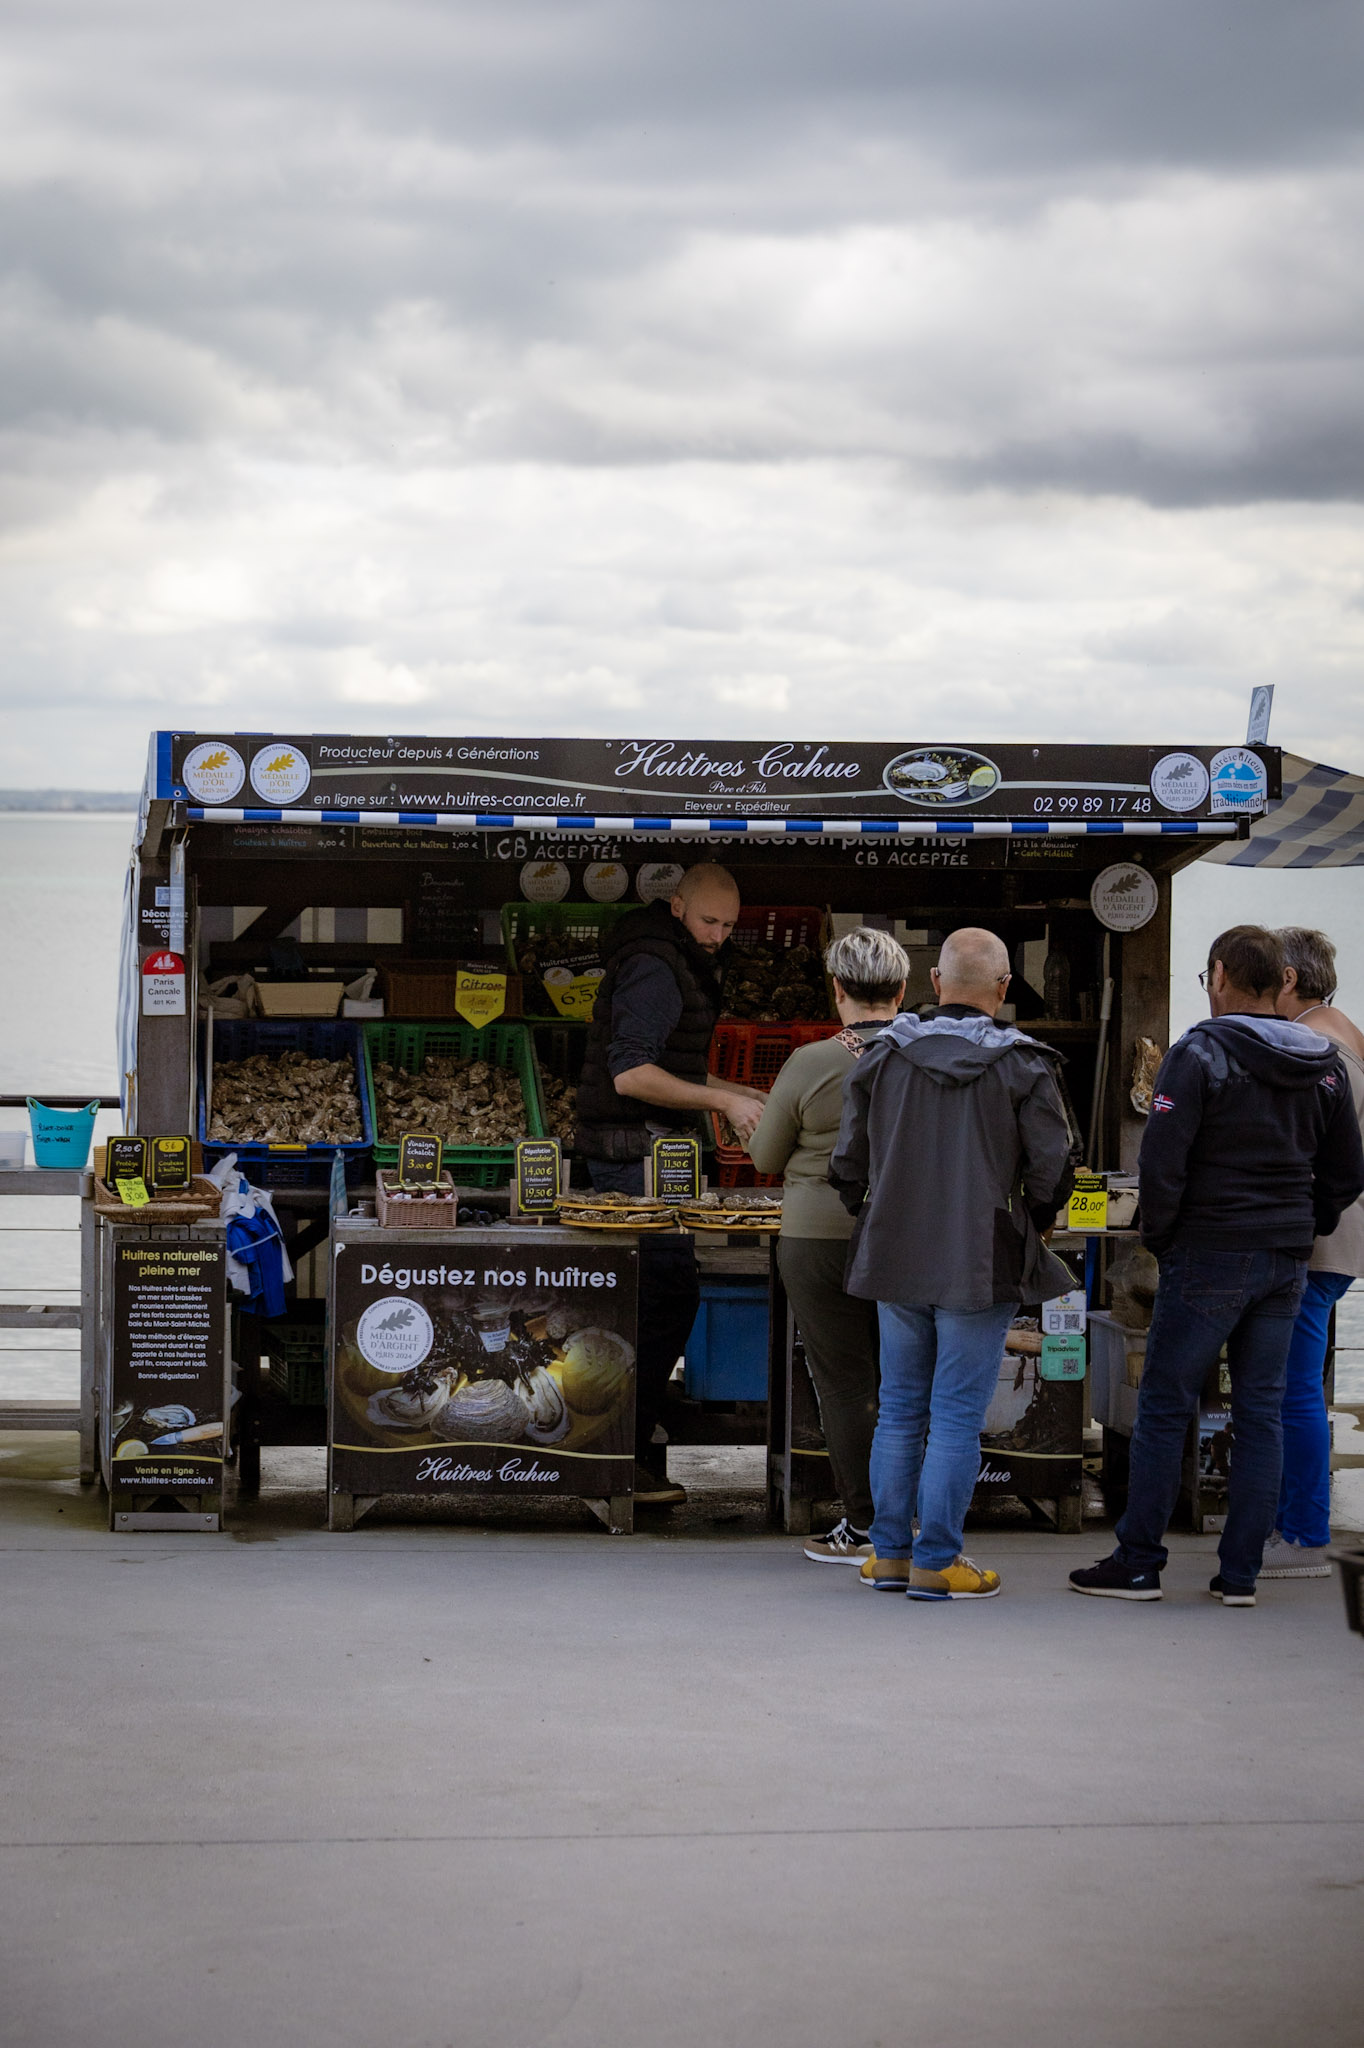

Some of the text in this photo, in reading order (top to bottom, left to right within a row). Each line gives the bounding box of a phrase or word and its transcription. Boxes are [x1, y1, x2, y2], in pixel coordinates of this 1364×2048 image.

[319, 746, 539, 761] Producteur depuis 4 Générations
[614, 742, 861, 778] Huîtres Cahue
[193, 771, 235, 779] MÉDAILLE
[260, 772, 300, 780] MÉDAILLE
[203, 778, 224, 786] D'OR
[1161, 780, 1198, 788] MÉDAILLE
[708, 780, 767, 794] Père et Fils
[314, 791, 586, 808] en ligne sur www.huitres-cancale.fr
[1213, 792, 1263, 809] traditionnel
[684, 801, 791, 813] Eleveur Expéditeur
[1033, 796, 1151, 813] 02 99 89 17 48
[317, 840, 336, 848] 4,00
[361, 840, 401, 848] Ouverture
[403, 840, 418, 848] des
[497, 837, 621, 860] CB ACCEPTÉE
[855, 849, 969, 866] CB ACCEPTÉE
[1103, 894, 1146, 903] MÉDAILLE
[1103, 903, 1144, 911] D'ARGENT
[153, 978, 175, 986] Paris
[461, 978, 502, 991] Citron
[115, 1144, 142, 1153] 2,50 €
[407, 1140, 436, 1150] Vinaigre
[407, 1148, 435, 1157] échalote
[524, 1148, 551, 1156] Dégustation
[426, 1162, 434, 1170] €
[682, 1160, 689, 1168] €
[546, 1167, 553, 1175] €
[546, 1188, 553, 1197] €
[683, 1184, 690, 1192] €
[163, 1250, 219, 1261] naturelles
[139, 1265, 201, 1277] pleine mer
[361, 1263, 617, 1290] Dégustez nos huîtres
[153, 1320, 211, 1328] Mont-Saint-Michel.
[177, 1333, 209, 1341] d'élevage
[370, 1330, 420, 1342] MÉDAILLE
[370, 1340, 419, 1351] D'ARGENT
[158, 1350, 163, 1358] à
[375, 1350, 394, 1358] PARIS
[135, 1466, 159, 1474] Vente
[173, 1467, 194, 1476] ligne
[416, 1457, 560, 1482] Huîtres Cahue
[976, 1461, 1012, 1483] hue
